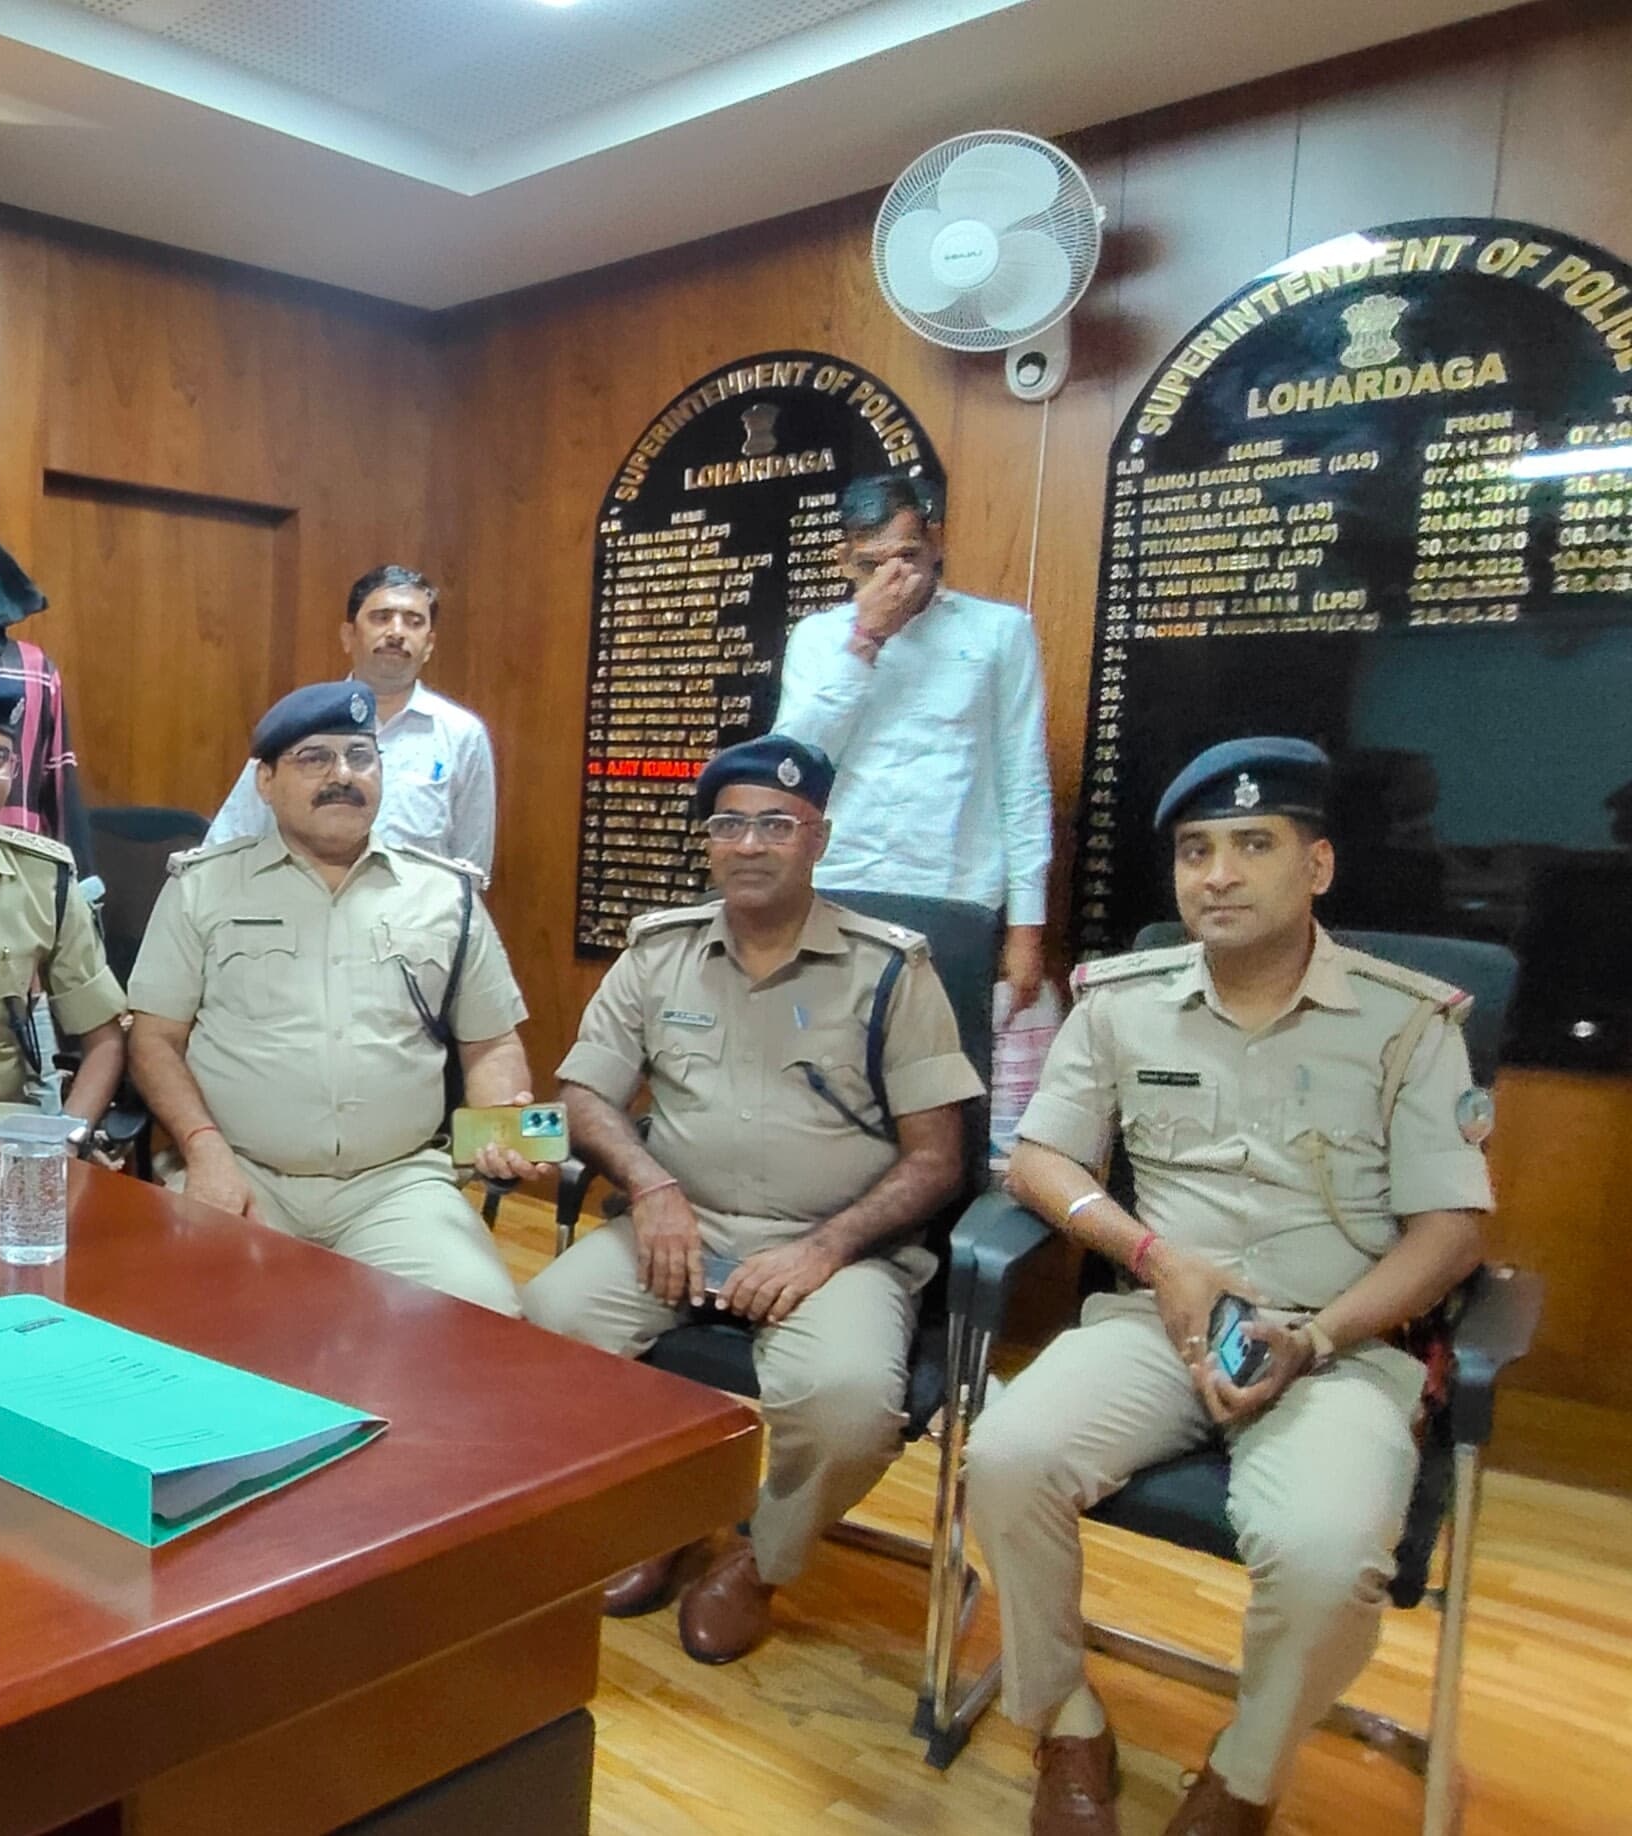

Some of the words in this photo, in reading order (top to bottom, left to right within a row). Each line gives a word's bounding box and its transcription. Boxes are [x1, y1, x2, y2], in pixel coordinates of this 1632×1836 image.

[1136, 235, 1475, 436] SUPERINTENDENT
[1477, 238, 1552, 278] OF
[1247, 352, 1508, 419] LOHARDAGA
[614, 361, 813, 502] SUPERINTENDENT
[813, 365, 855, 395] OF
[846, 381, 920, 467] POLICE
[684, 447, 836, 491] LOHARDAGA
[1134, 622, 1208, 638] SADIQUE
